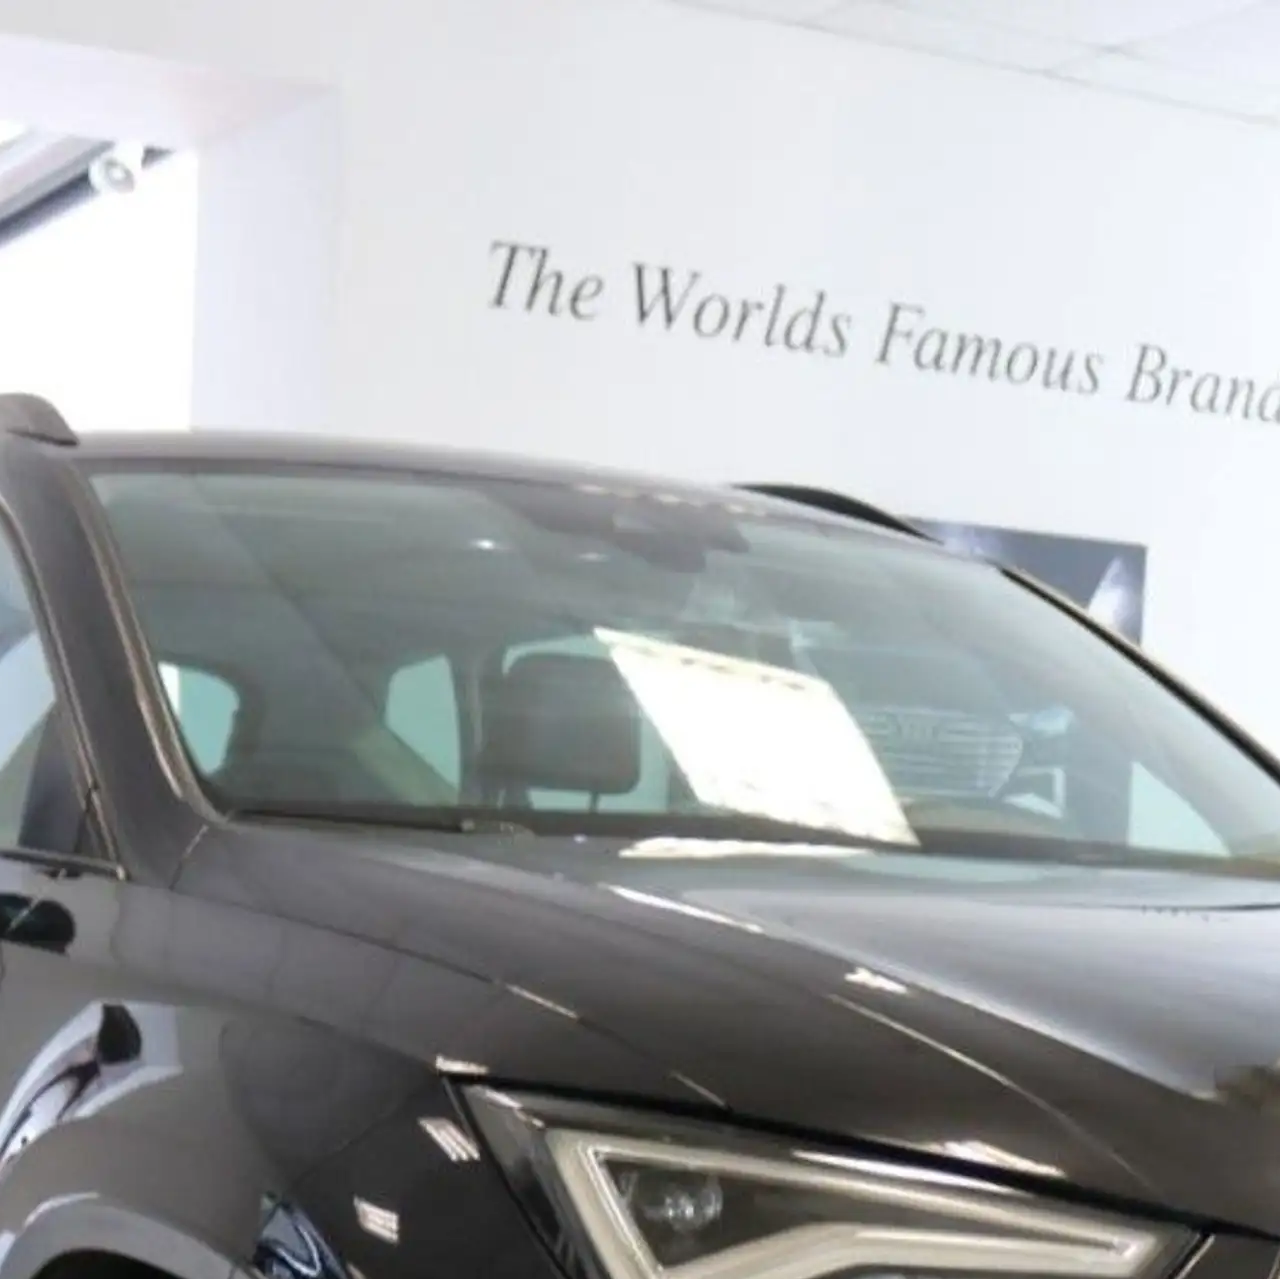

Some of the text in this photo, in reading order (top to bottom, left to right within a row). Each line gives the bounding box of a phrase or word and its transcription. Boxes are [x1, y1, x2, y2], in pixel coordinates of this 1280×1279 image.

[490, 239, 605, 331] The
[632, 261, 849, 359] Worlds
[874, 302, 1102, 396] Famous
